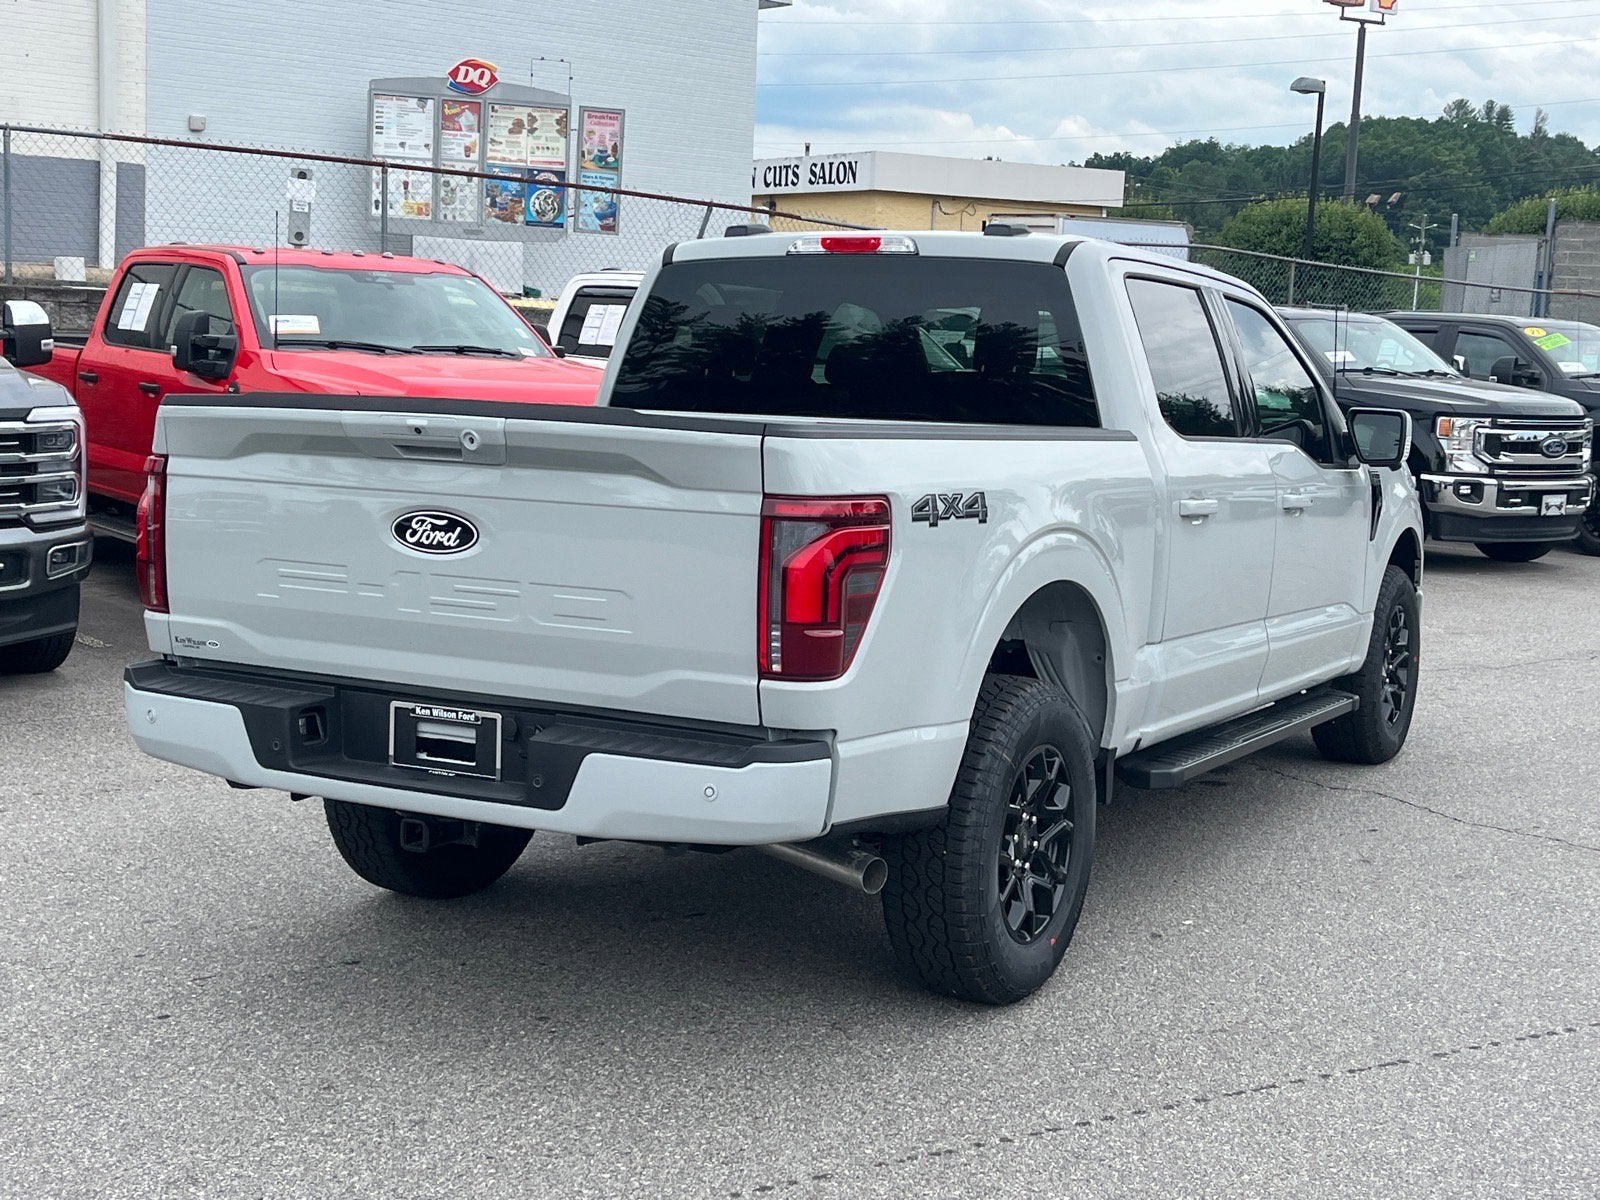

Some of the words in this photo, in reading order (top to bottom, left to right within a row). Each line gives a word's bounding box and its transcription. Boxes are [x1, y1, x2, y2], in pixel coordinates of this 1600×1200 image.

[456, 65, 491, 88] DQ
[763, 164, 800, 188] CUTS
[808, 160, 858, 185] SALON
[405, 516, 460, 547] Ford
[415, 706, 431, 716] Ken
[432, 707, 457, 719] Wilson
[458, 711, 475, 721] Ford
